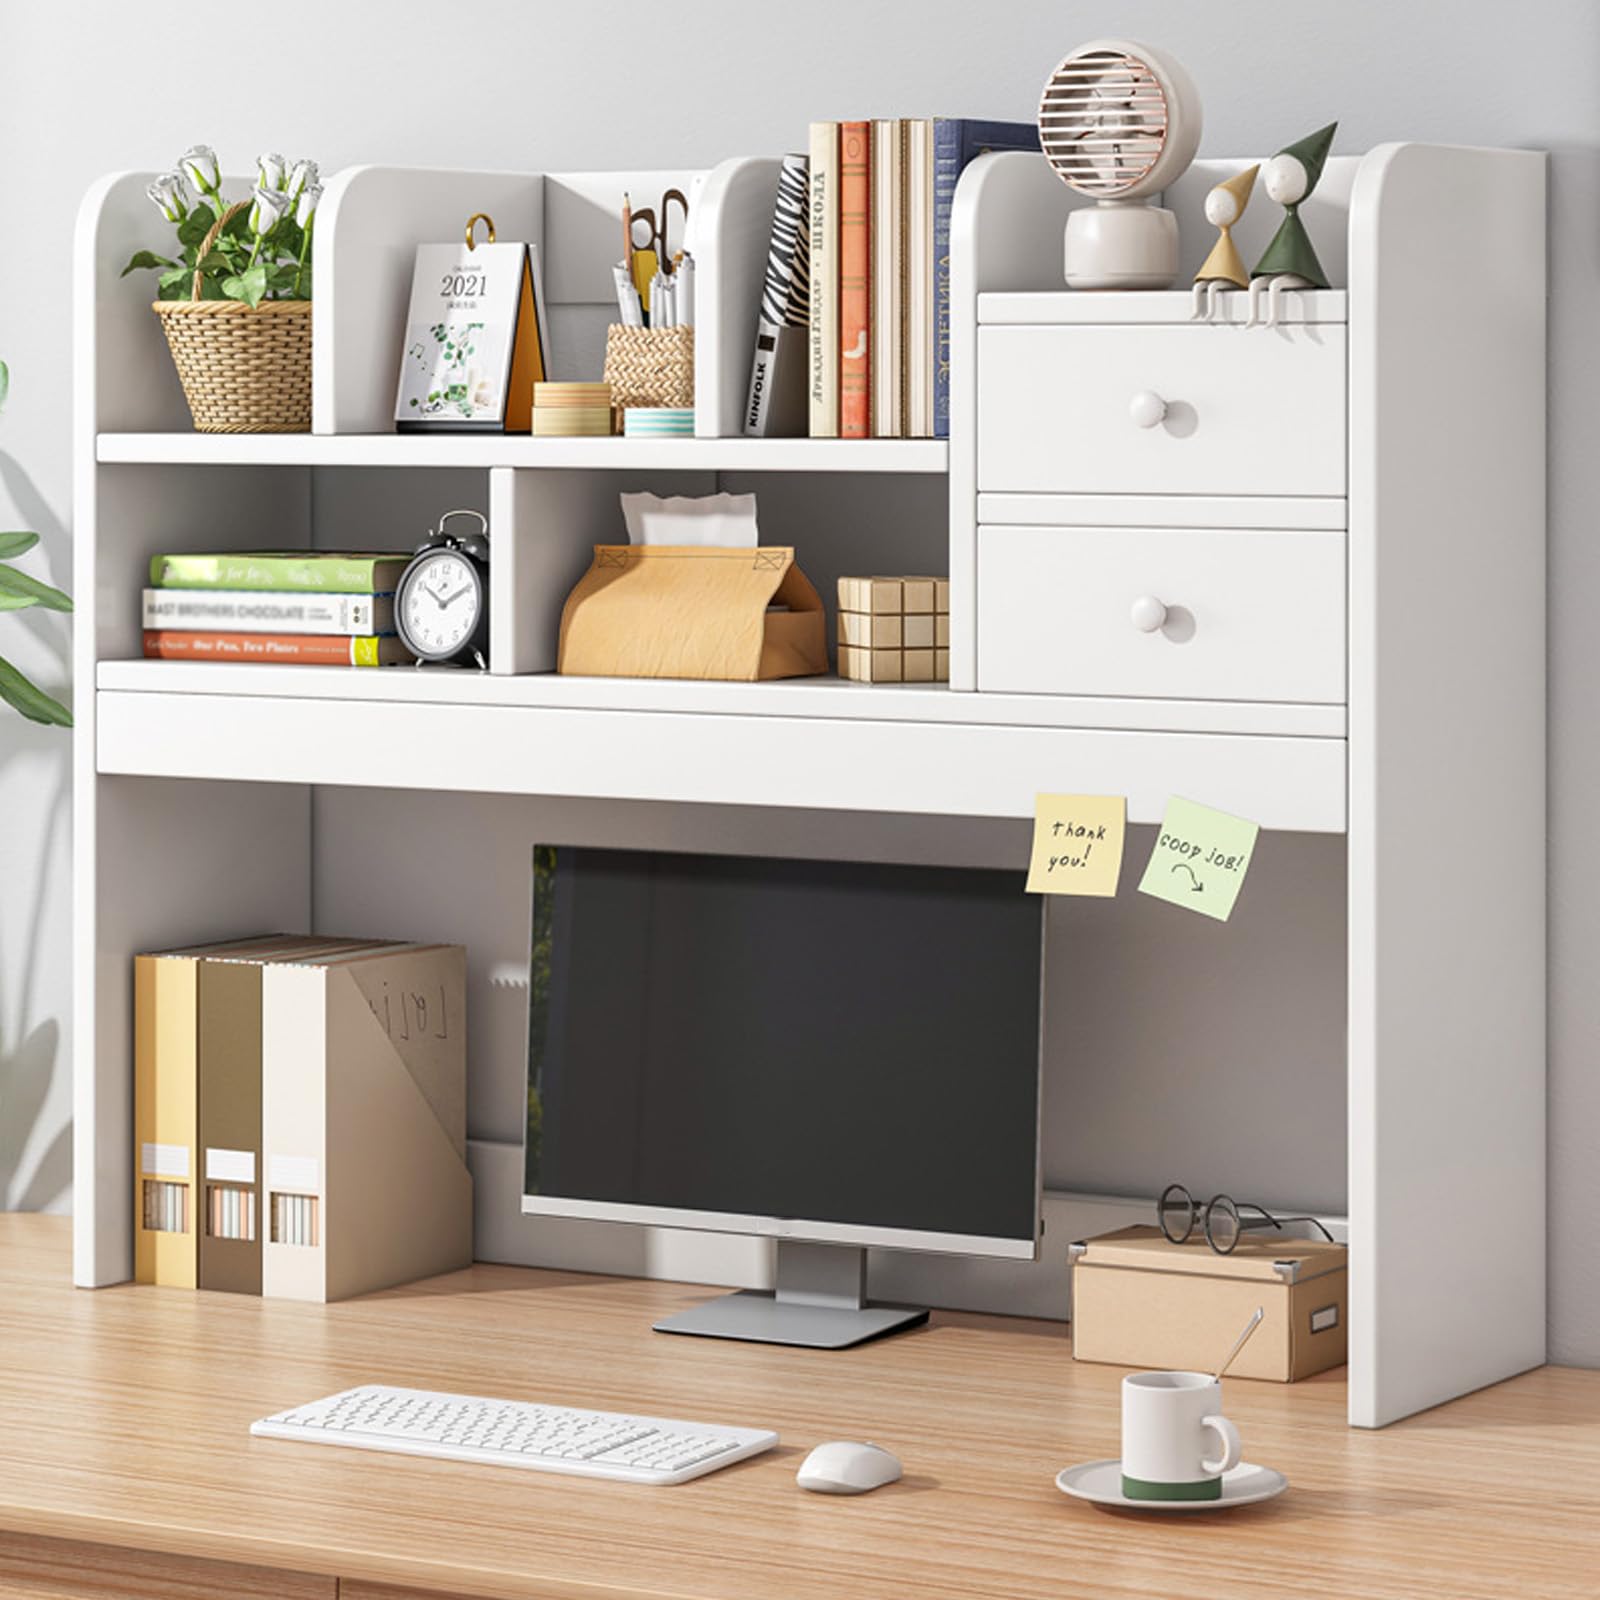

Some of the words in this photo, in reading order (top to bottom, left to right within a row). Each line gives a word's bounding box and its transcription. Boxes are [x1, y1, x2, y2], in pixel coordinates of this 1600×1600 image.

[812, 171, 825, 250] ШКОЛА
[440, 274, 486, 297] 2021
[749, 363, 767, 427] KINFOLK
[1052, 821, 1106, 841] thank
[1048, 844, 1092, 872] you!
